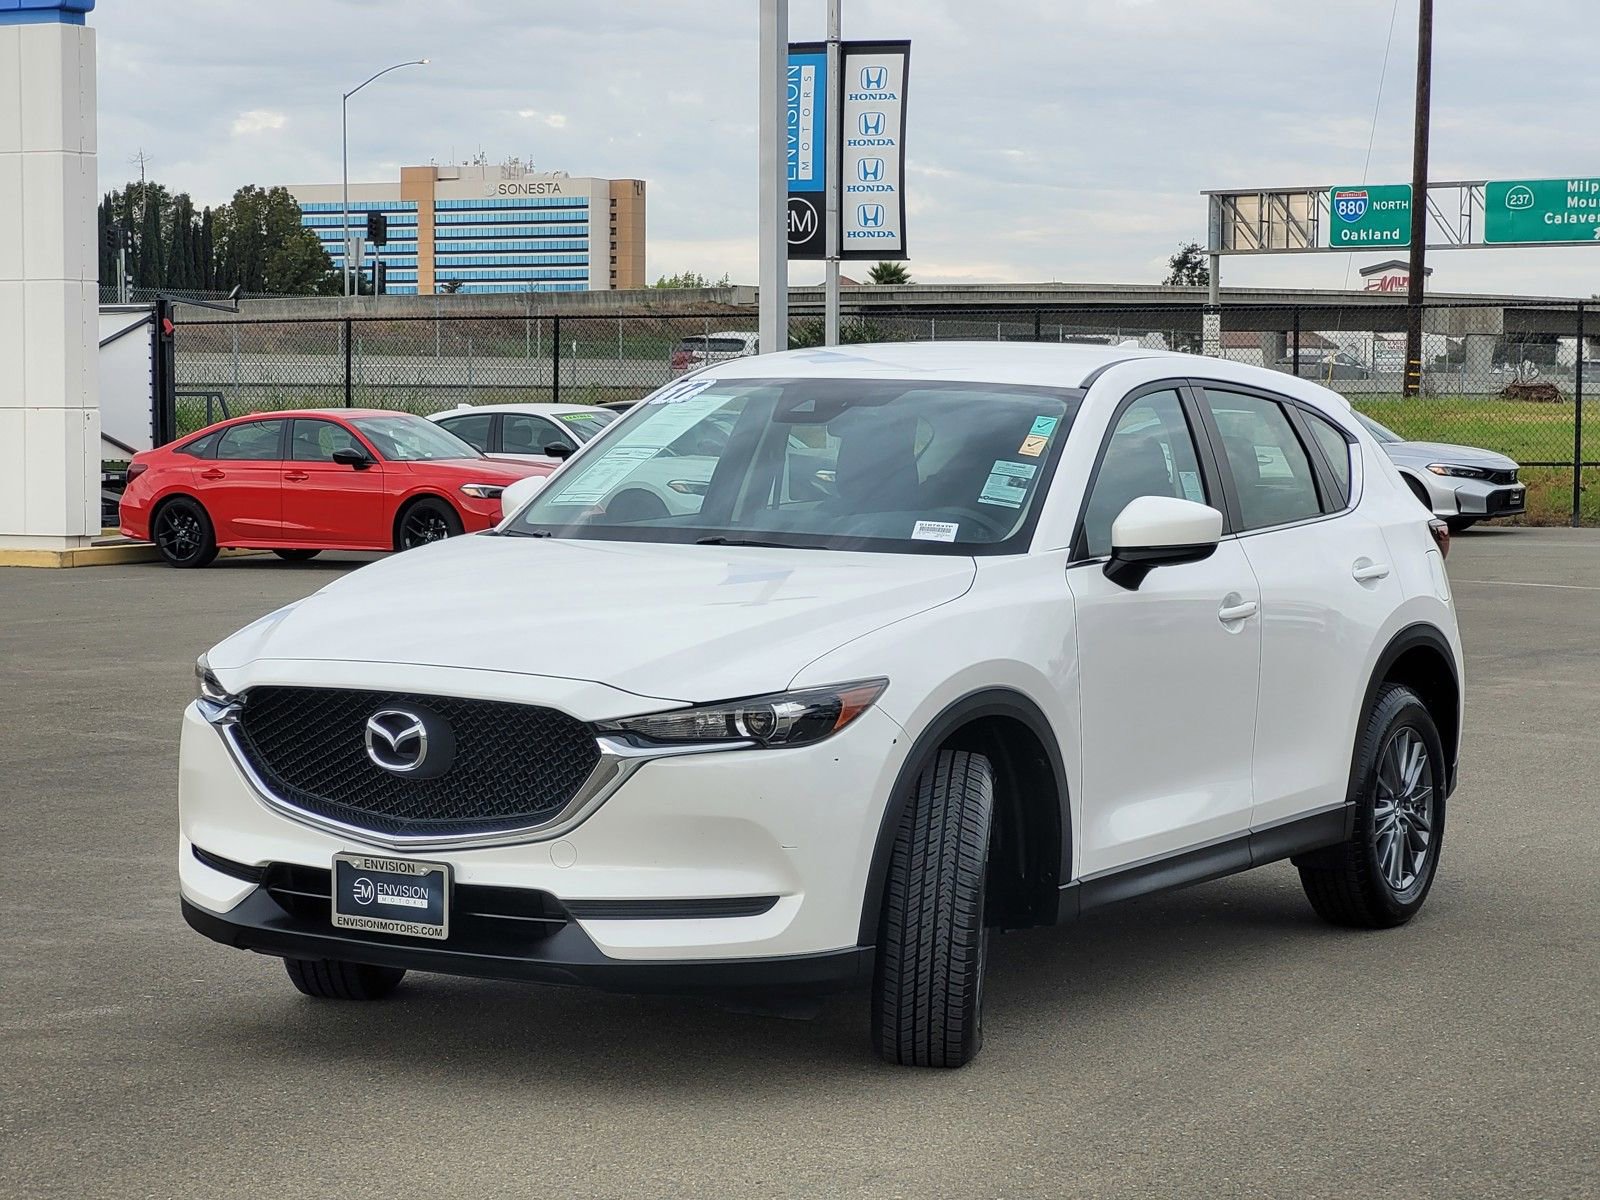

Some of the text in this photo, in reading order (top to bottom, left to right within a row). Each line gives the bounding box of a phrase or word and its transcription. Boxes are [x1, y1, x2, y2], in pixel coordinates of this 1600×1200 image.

[848, 93, 897, 101] HONDA
[801, 75, 812, 171] MOTORS
[847, 138, 895, 147] HONDA
[498, 183, 562, 195] SONESTA
[846, 184, 895, 192] HONDA
[1510, 194, 1530, 205] 237
[1567, 196, 1600, 208] Mou
[1338, 200, 1409, 215] 880 NORTH
[787, 210, 812, 232] M
[1341, 228, 1400, 240] Oakland
[364, 859, 416, 873] ENVISION
[377, 882, 429, 899] ENVISION
[381, 897, 424, 906] MOTORS
[337, 916, 443, 937] ENVISIONMOTORS.COM
